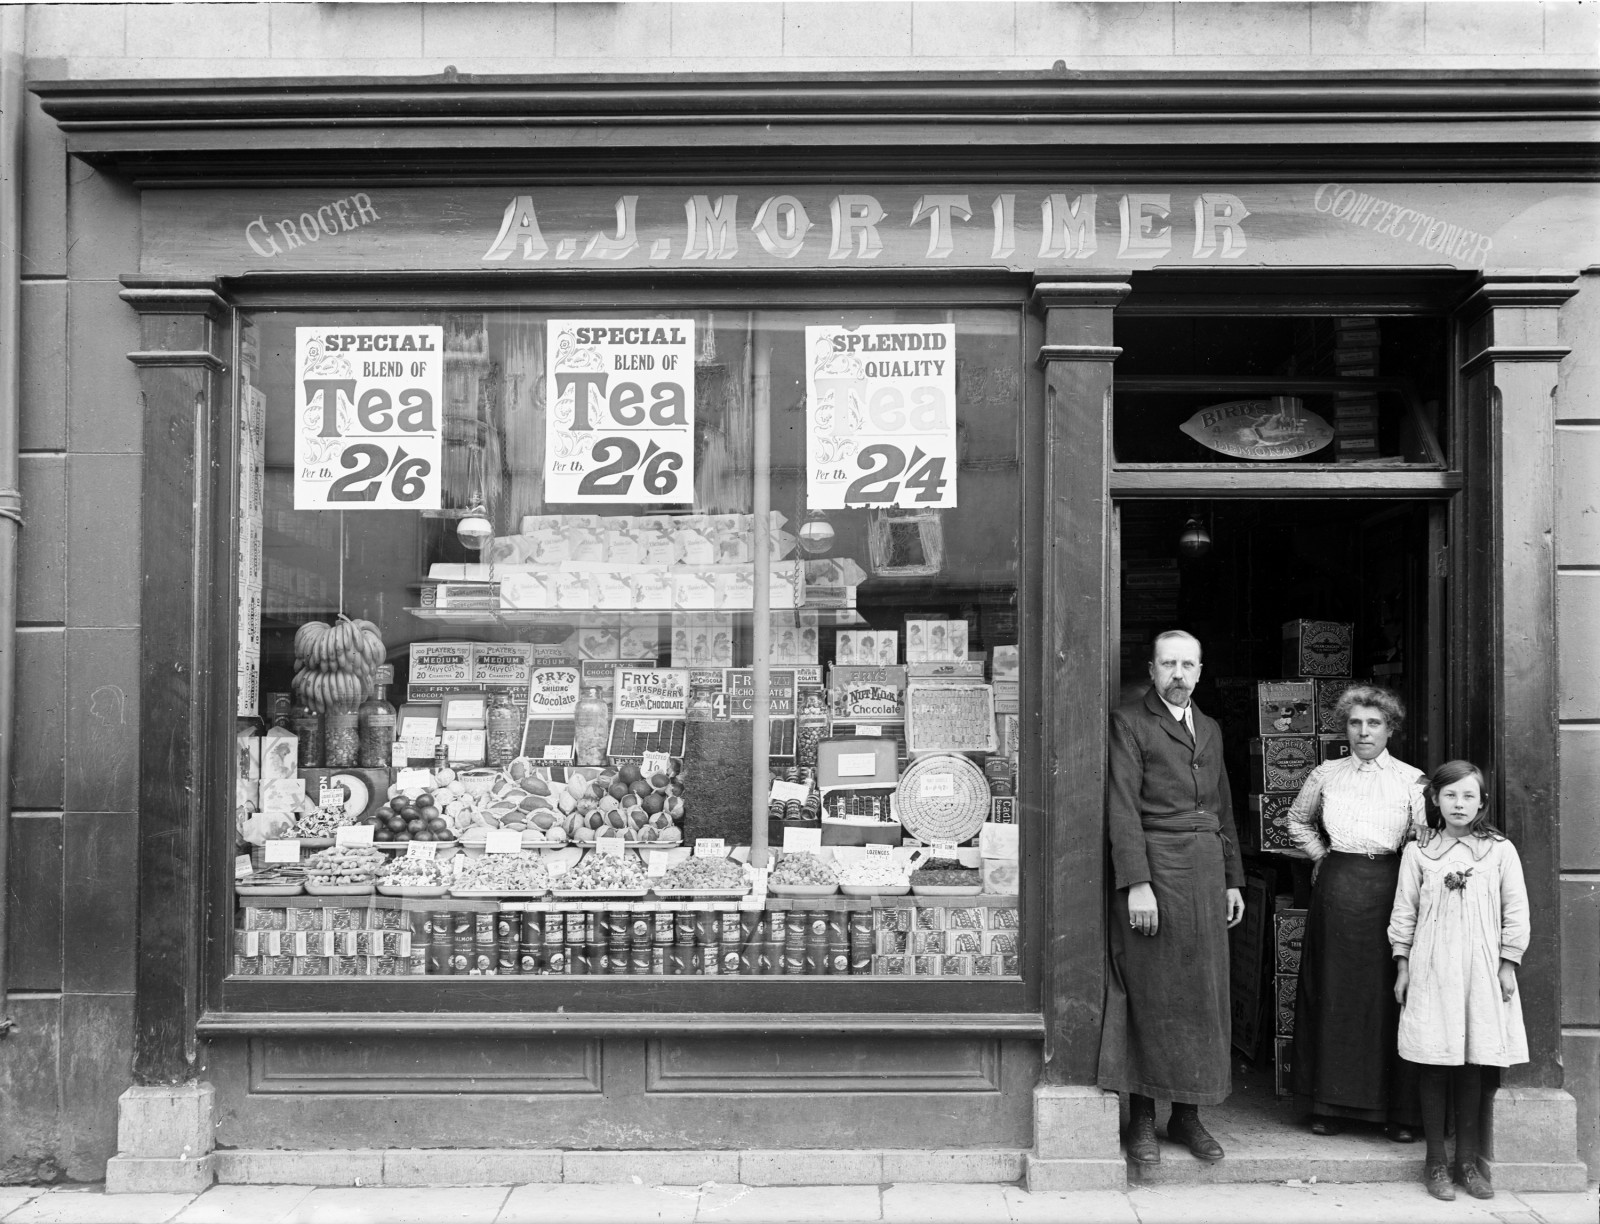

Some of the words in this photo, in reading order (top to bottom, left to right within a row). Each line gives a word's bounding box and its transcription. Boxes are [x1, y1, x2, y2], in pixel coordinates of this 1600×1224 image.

[245, 192, 381, 259] GROCER
[682, 193, 1252, 260] MORTIMER
[1314, 183, 1493, 267] CONFECTIONER
[325, 334, 435, 352] SPECIAL
[576, 327, 687, 345] SPECIAL
[833, 332, 946, 352] SPLENDID
[363, 361, 403, 378] BLEND
[411, 361, 427, 377] OF
[614, 354, 655, 371] BLEND
[662, 354, 678, 371] OF
[865, 360, 946, 378] QUALITY
[303, 378, 437, 438] Tea
[555, 372, 689, 431] Tea
[814, 378, 950, 437] Tea
[301, 467, 317, 479] Per
[552, 461, 567, 472] Per
[816, 469, 830, 481] Per
[426, 647, 456, 655] PLAYER'S
[487, 647, 516, 655] PLAYER'S
[427, 665, 444, 673] NAVY
[445, 664, 455, 672] CUT
[487, 665, 503, 673] NAVY
[1303, 652, 1348, 674] BISCUITS
[416, 671, 426, 679] 20
[455, 671, 464, 679] 20
[476, 671, 486, 679] 20
[515, 671, 525, 679] 20
[536, 672, 576, 684] FRY'S
[621, 671, 660, 689] FRY'S
[533, 693, 576, 706] Chocolate
[636, 686, 684, 698] RASPBERRY
[849, 689, 871, 706] NUT
[647, 699, 684, 710] CHOCOLATE
[713, 694, 727, 718] 4
[852, 704, 901, 714] Chocolate
[1264, 801, 1278, 819] PEEK
[1265, 827, 1295, 847] BISCU
[1278, 922, 1293, 941] PEEK
